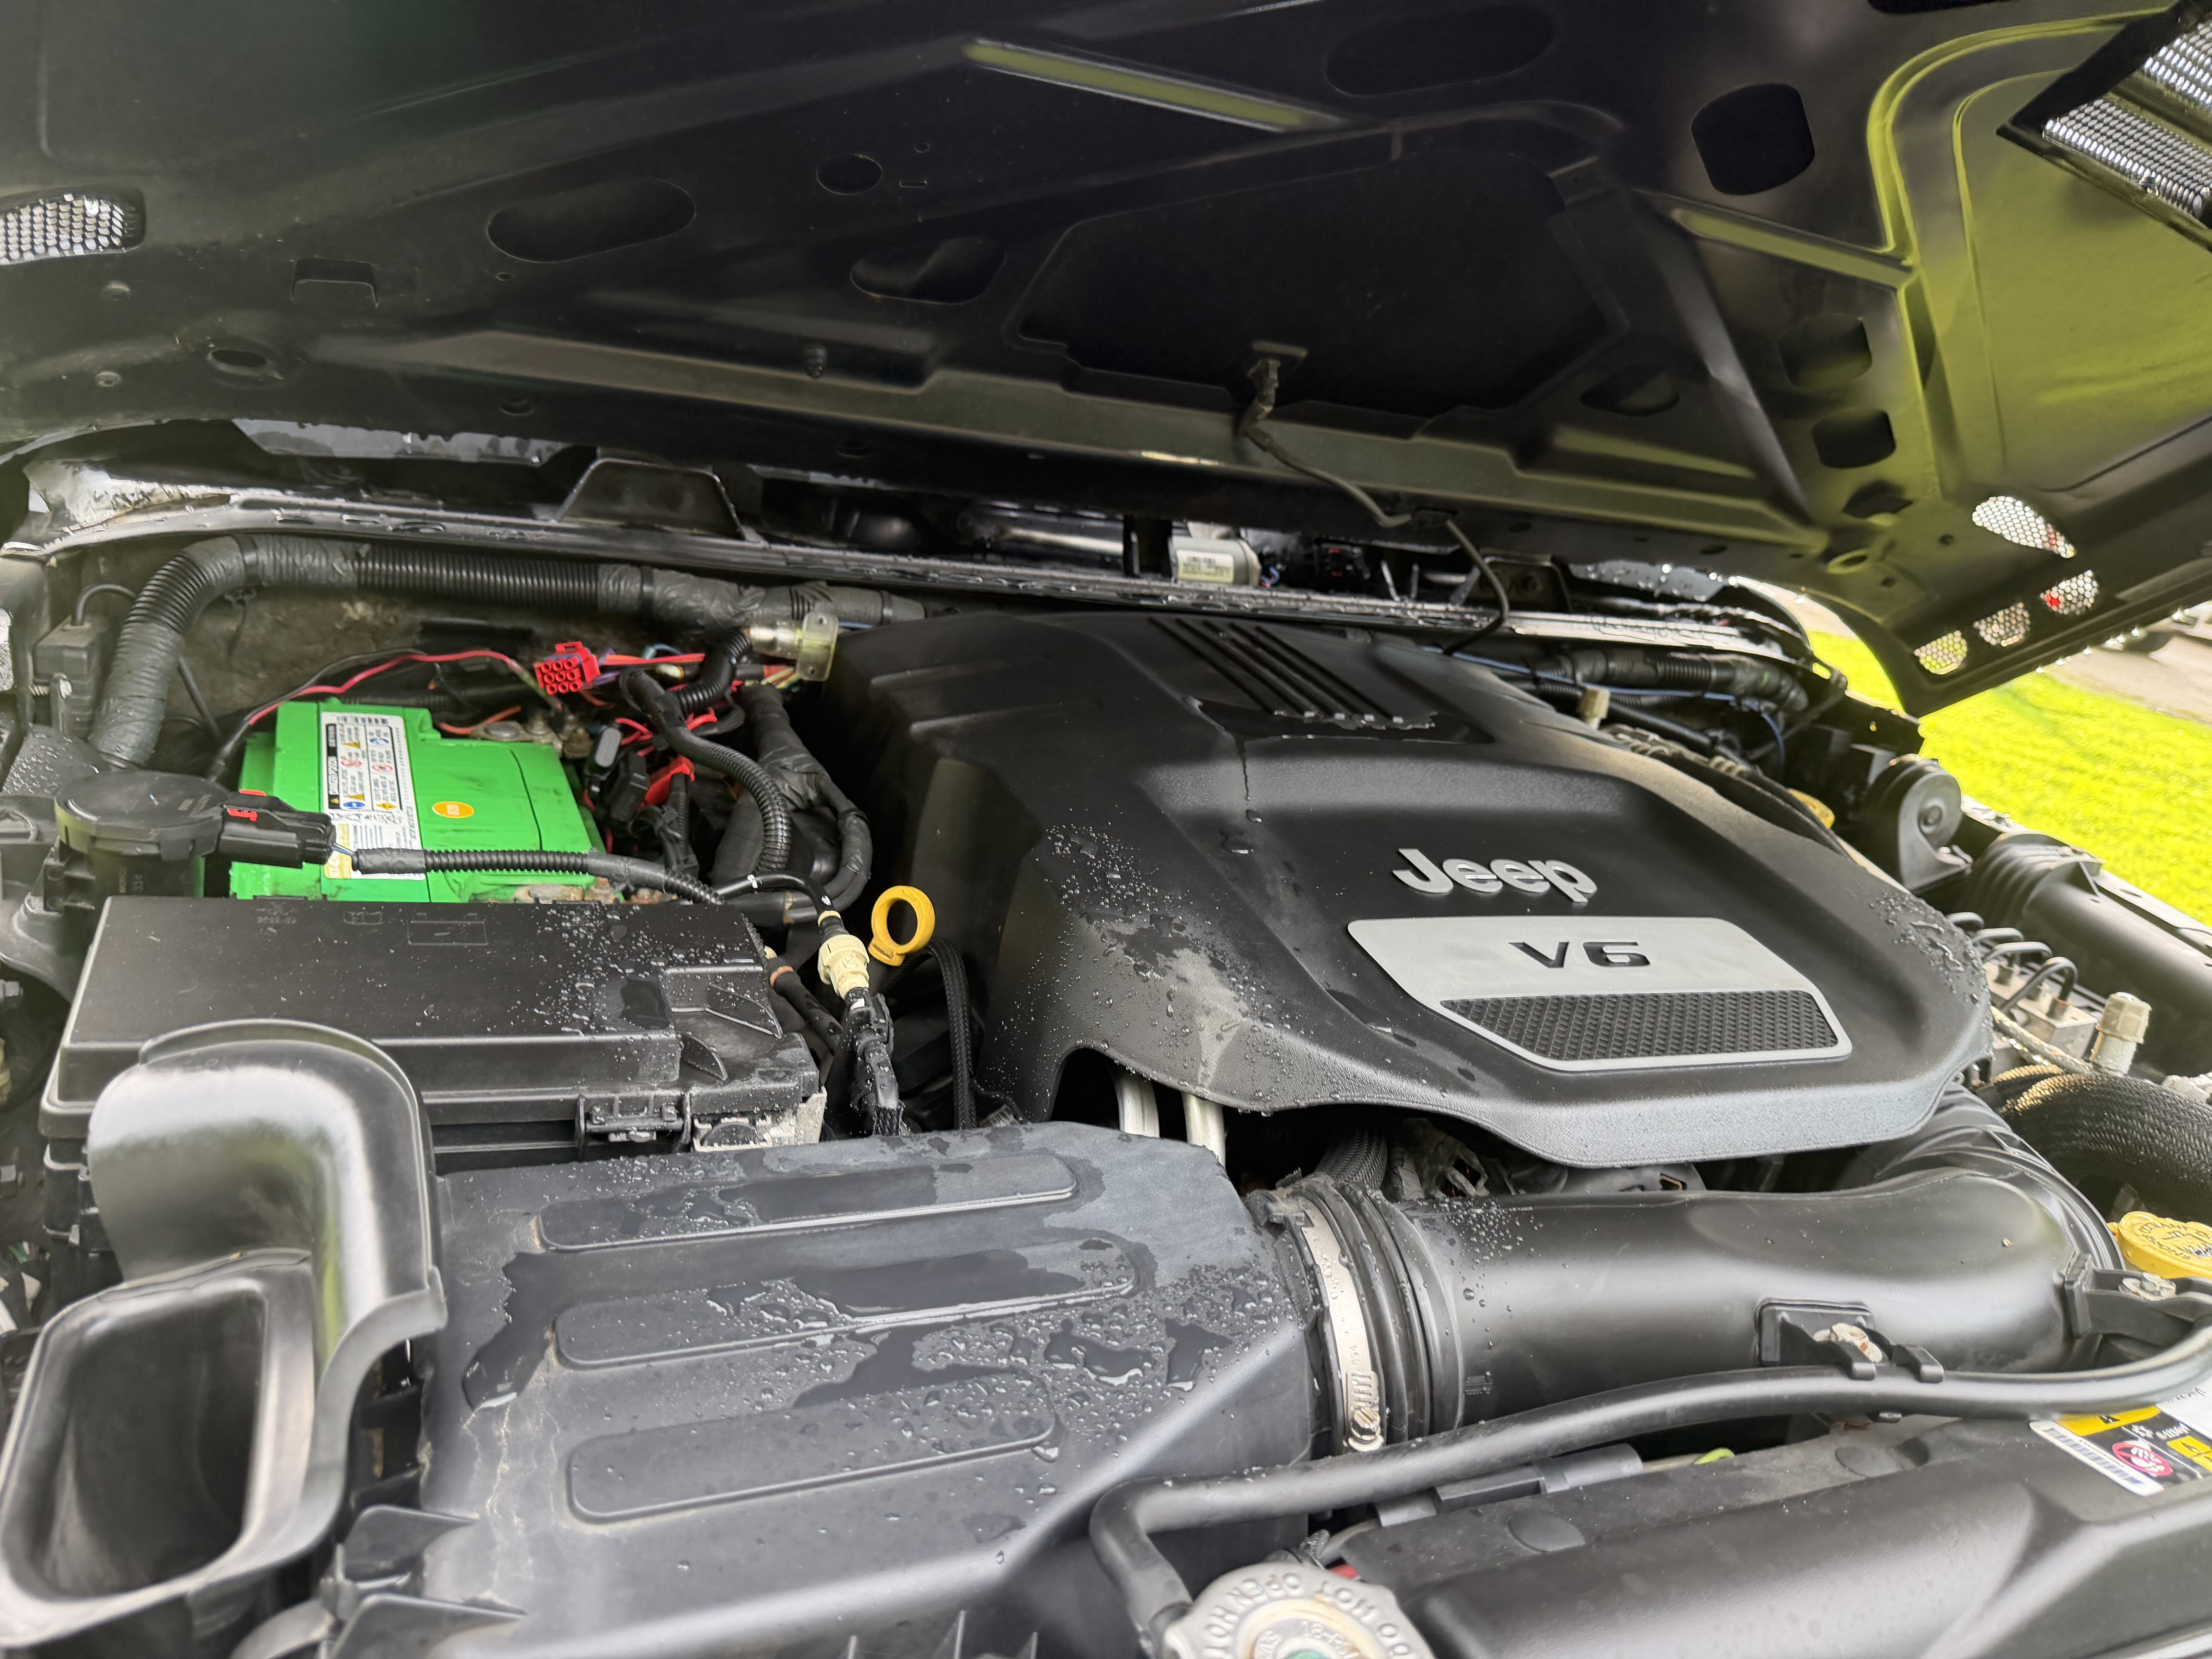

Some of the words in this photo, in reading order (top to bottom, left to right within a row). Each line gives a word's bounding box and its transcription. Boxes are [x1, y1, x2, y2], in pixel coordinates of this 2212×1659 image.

[1393, 848, 1598, 902] Jeep
[1508, 941, 1651, 968] V6
[1226, 1572, 1305, 1606] OPEN
